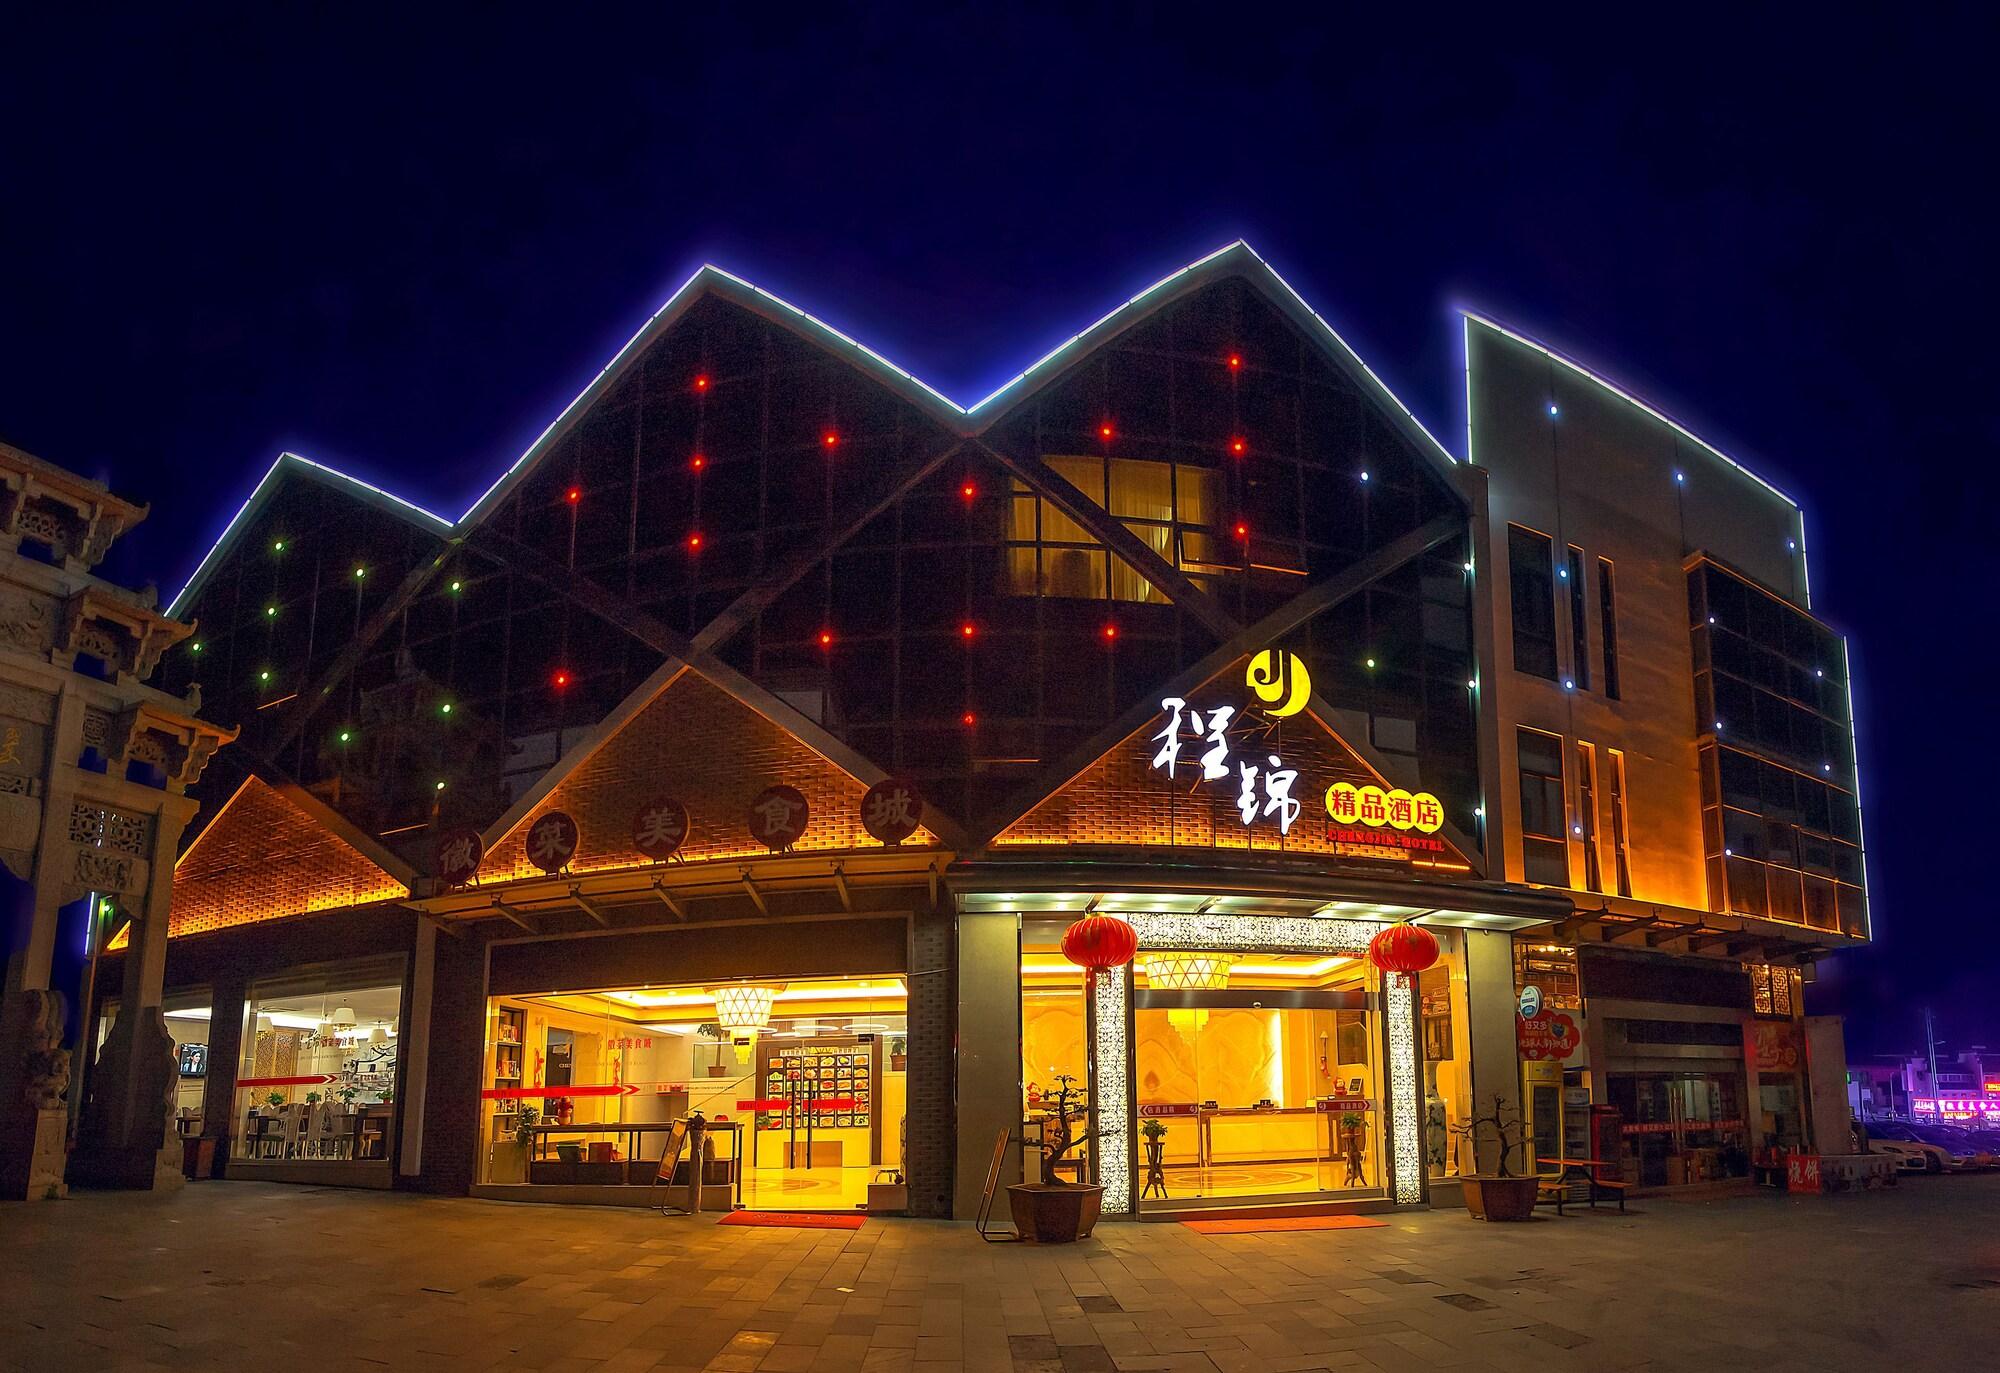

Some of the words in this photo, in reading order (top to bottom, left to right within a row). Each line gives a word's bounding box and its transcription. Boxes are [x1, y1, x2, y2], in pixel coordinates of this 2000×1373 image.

[1151, 697, 1300, 835] 程锦
[439, 789, 917, 872] 徽菜美食城
[1331, 789, 1441, 828] 精品酒店
[1399, 836, 1445, 852] HOTEL
